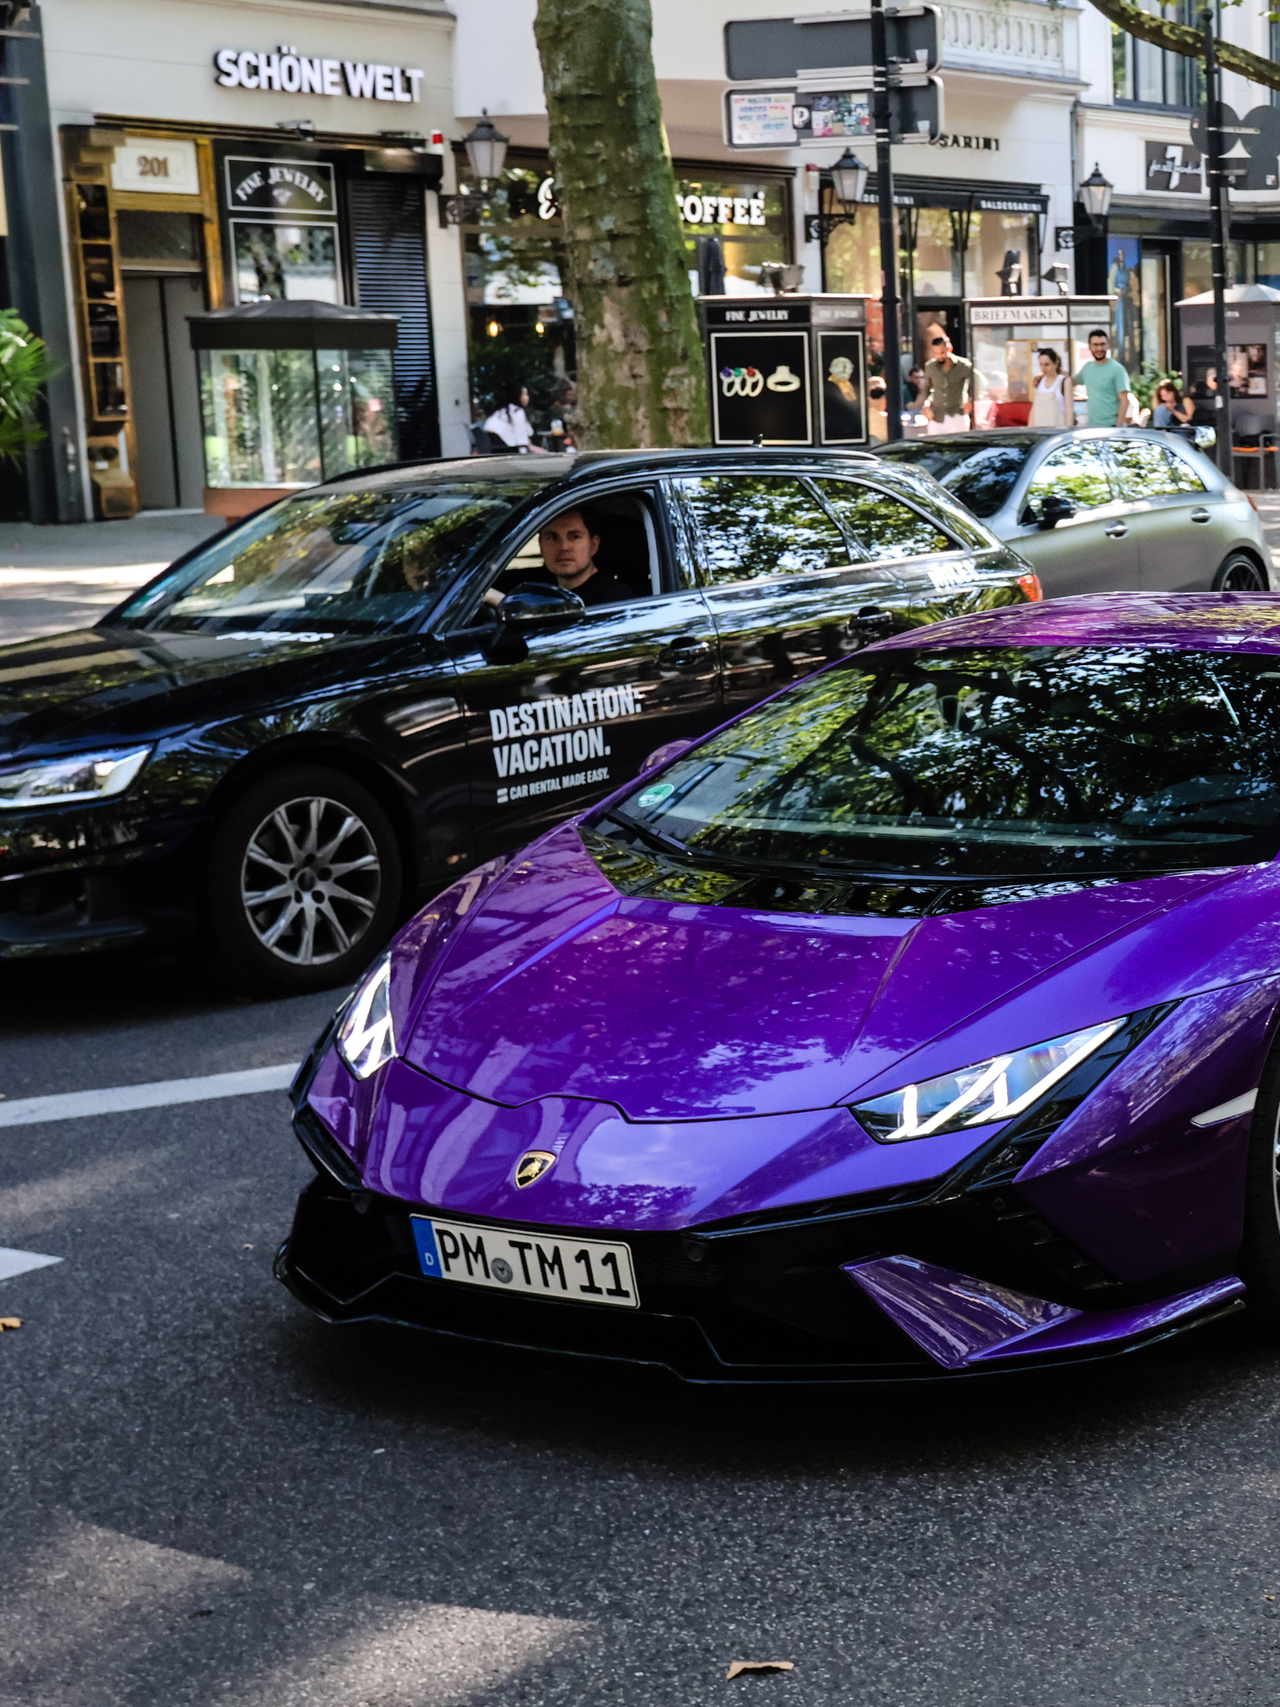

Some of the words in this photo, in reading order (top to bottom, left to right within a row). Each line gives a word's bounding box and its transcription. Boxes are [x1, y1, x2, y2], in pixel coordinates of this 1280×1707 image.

[215, 45, 342, 96] SCHÖNE
[344, 61, 425, 103] WELT
[137, 155, 170, 178] 201
[235, 170, 266, 202] FINE
[267, 166, 328, 203] JEWELRY
[725, 310, 746, 322] FINE
[747, 309, 789, 322] JEWELRY
[973, 308, 1065, 321] BRIEFMARKEN
[492, 726, 612, 778] VACATION.
[509, 784, 529, 801] CAR
[529, 777, 562, 796] RENTAL
[561, 771, 587, 789] MADE
[586, 766, 610, 784] EASY.
[424, 1252, 435, 1266] D
[435, 1228, 491, 1279] PM
[507, 1239, 568, 1291] TM
[574, 1248, 631, 1299] 11
